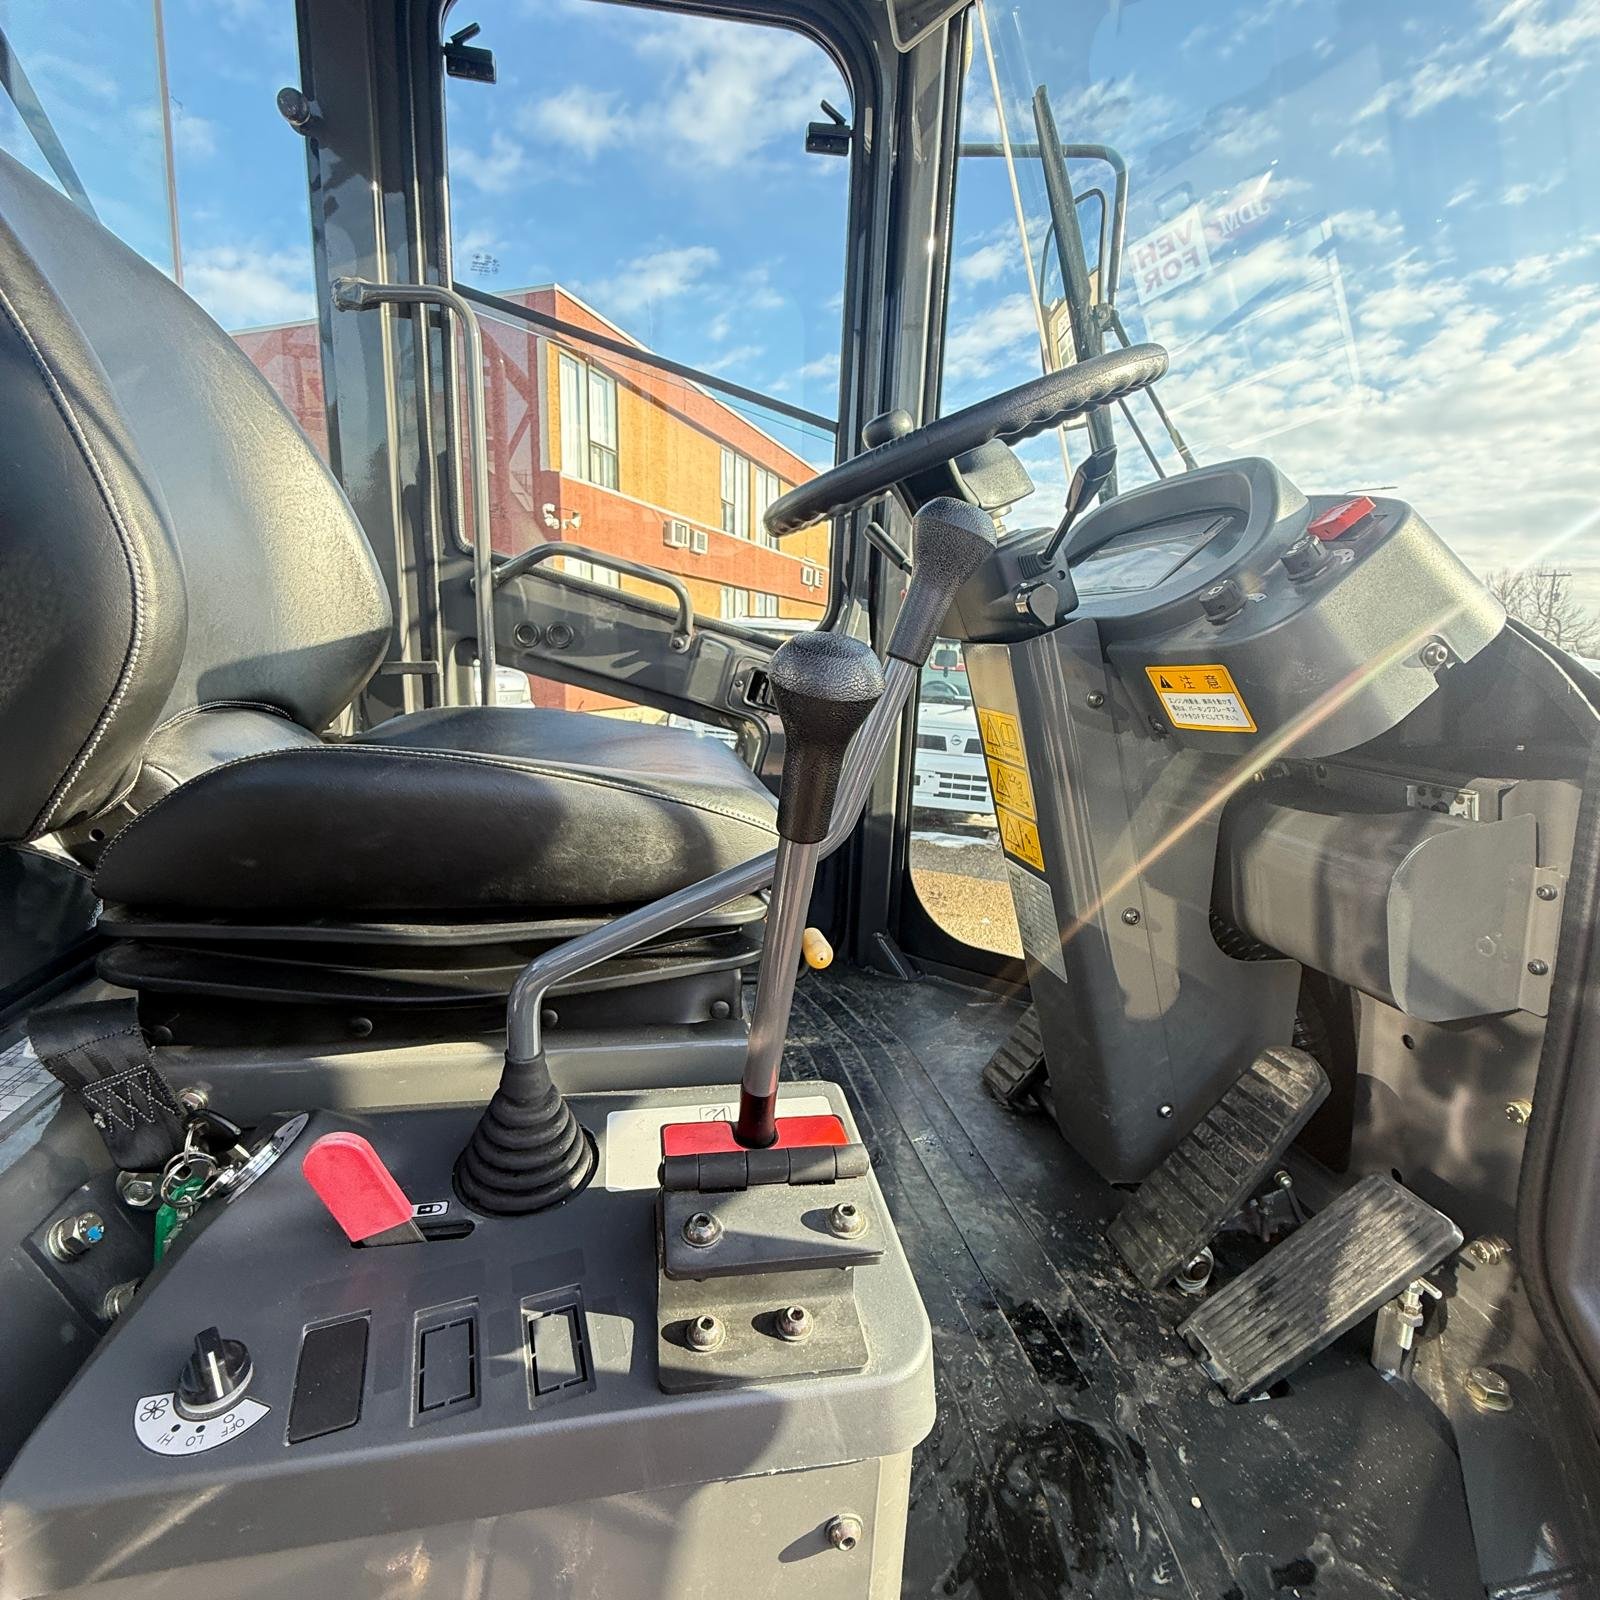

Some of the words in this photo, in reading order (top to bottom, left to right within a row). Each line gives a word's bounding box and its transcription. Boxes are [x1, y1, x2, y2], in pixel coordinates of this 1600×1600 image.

[1179, 674, 1222, 690] 注意
[220, 1418, 245, 1437] OFF
[157, 1433, 174, 1446] HI
[186, 1435, 204, 1446] LO
